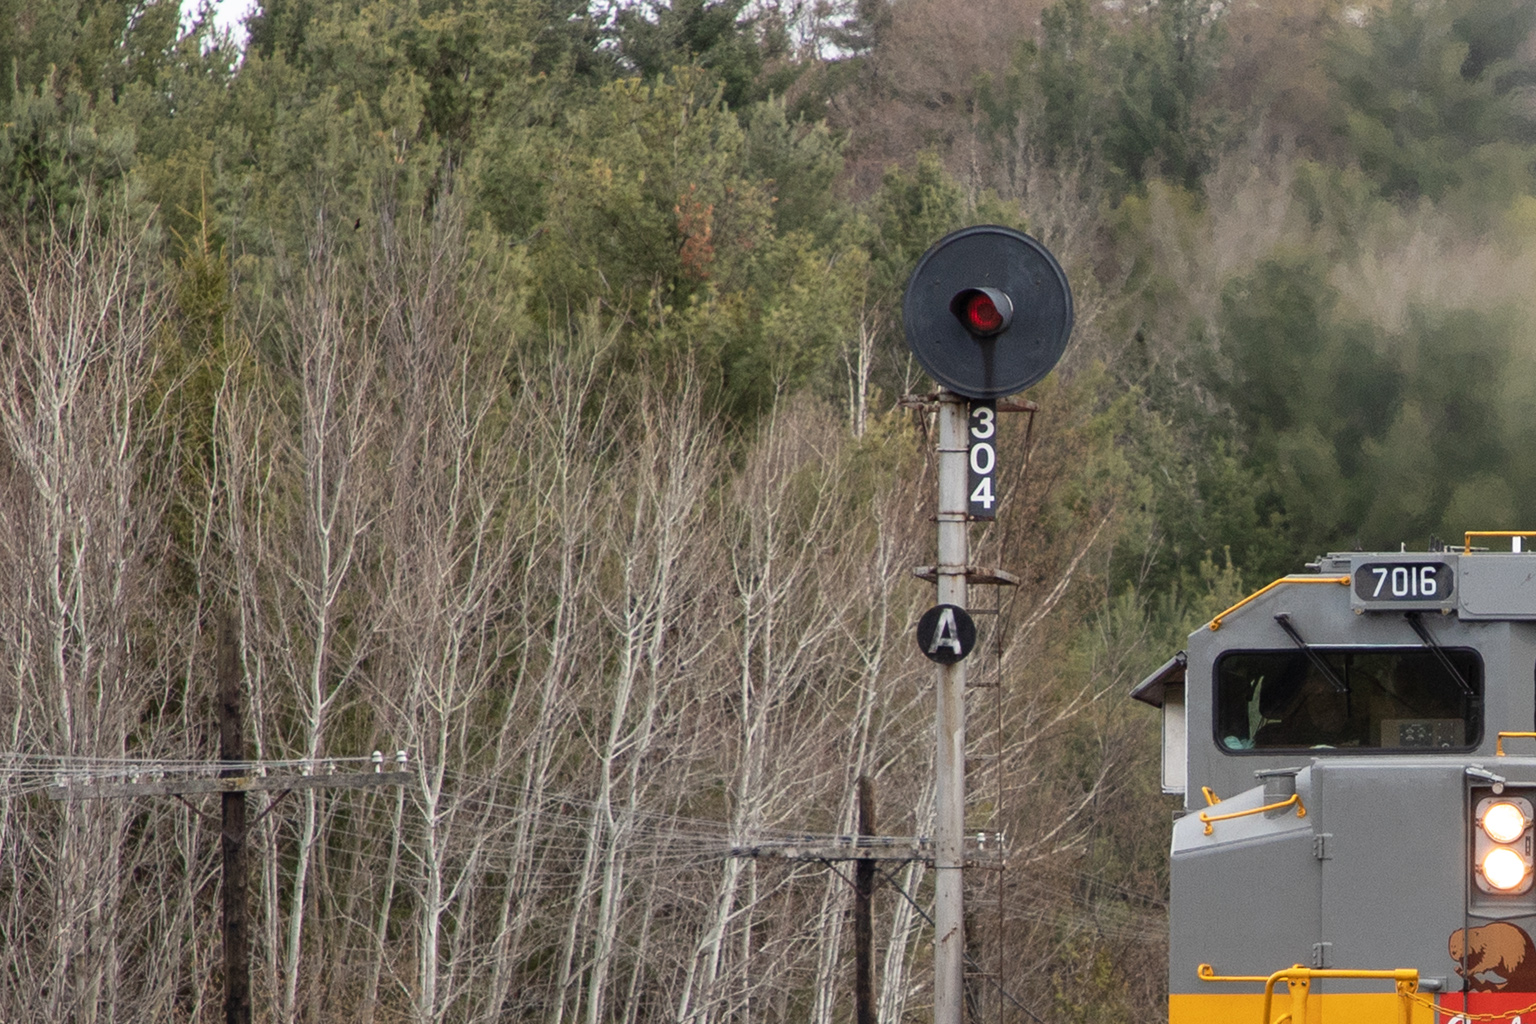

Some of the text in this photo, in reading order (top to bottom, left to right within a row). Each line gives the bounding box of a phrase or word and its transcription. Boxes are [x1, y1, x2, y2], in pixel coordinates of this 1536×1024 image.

[969, 406, 997, 510] 304
[1371, 566, 1437, 598] 7016
[927, 607, 963, 657] A
